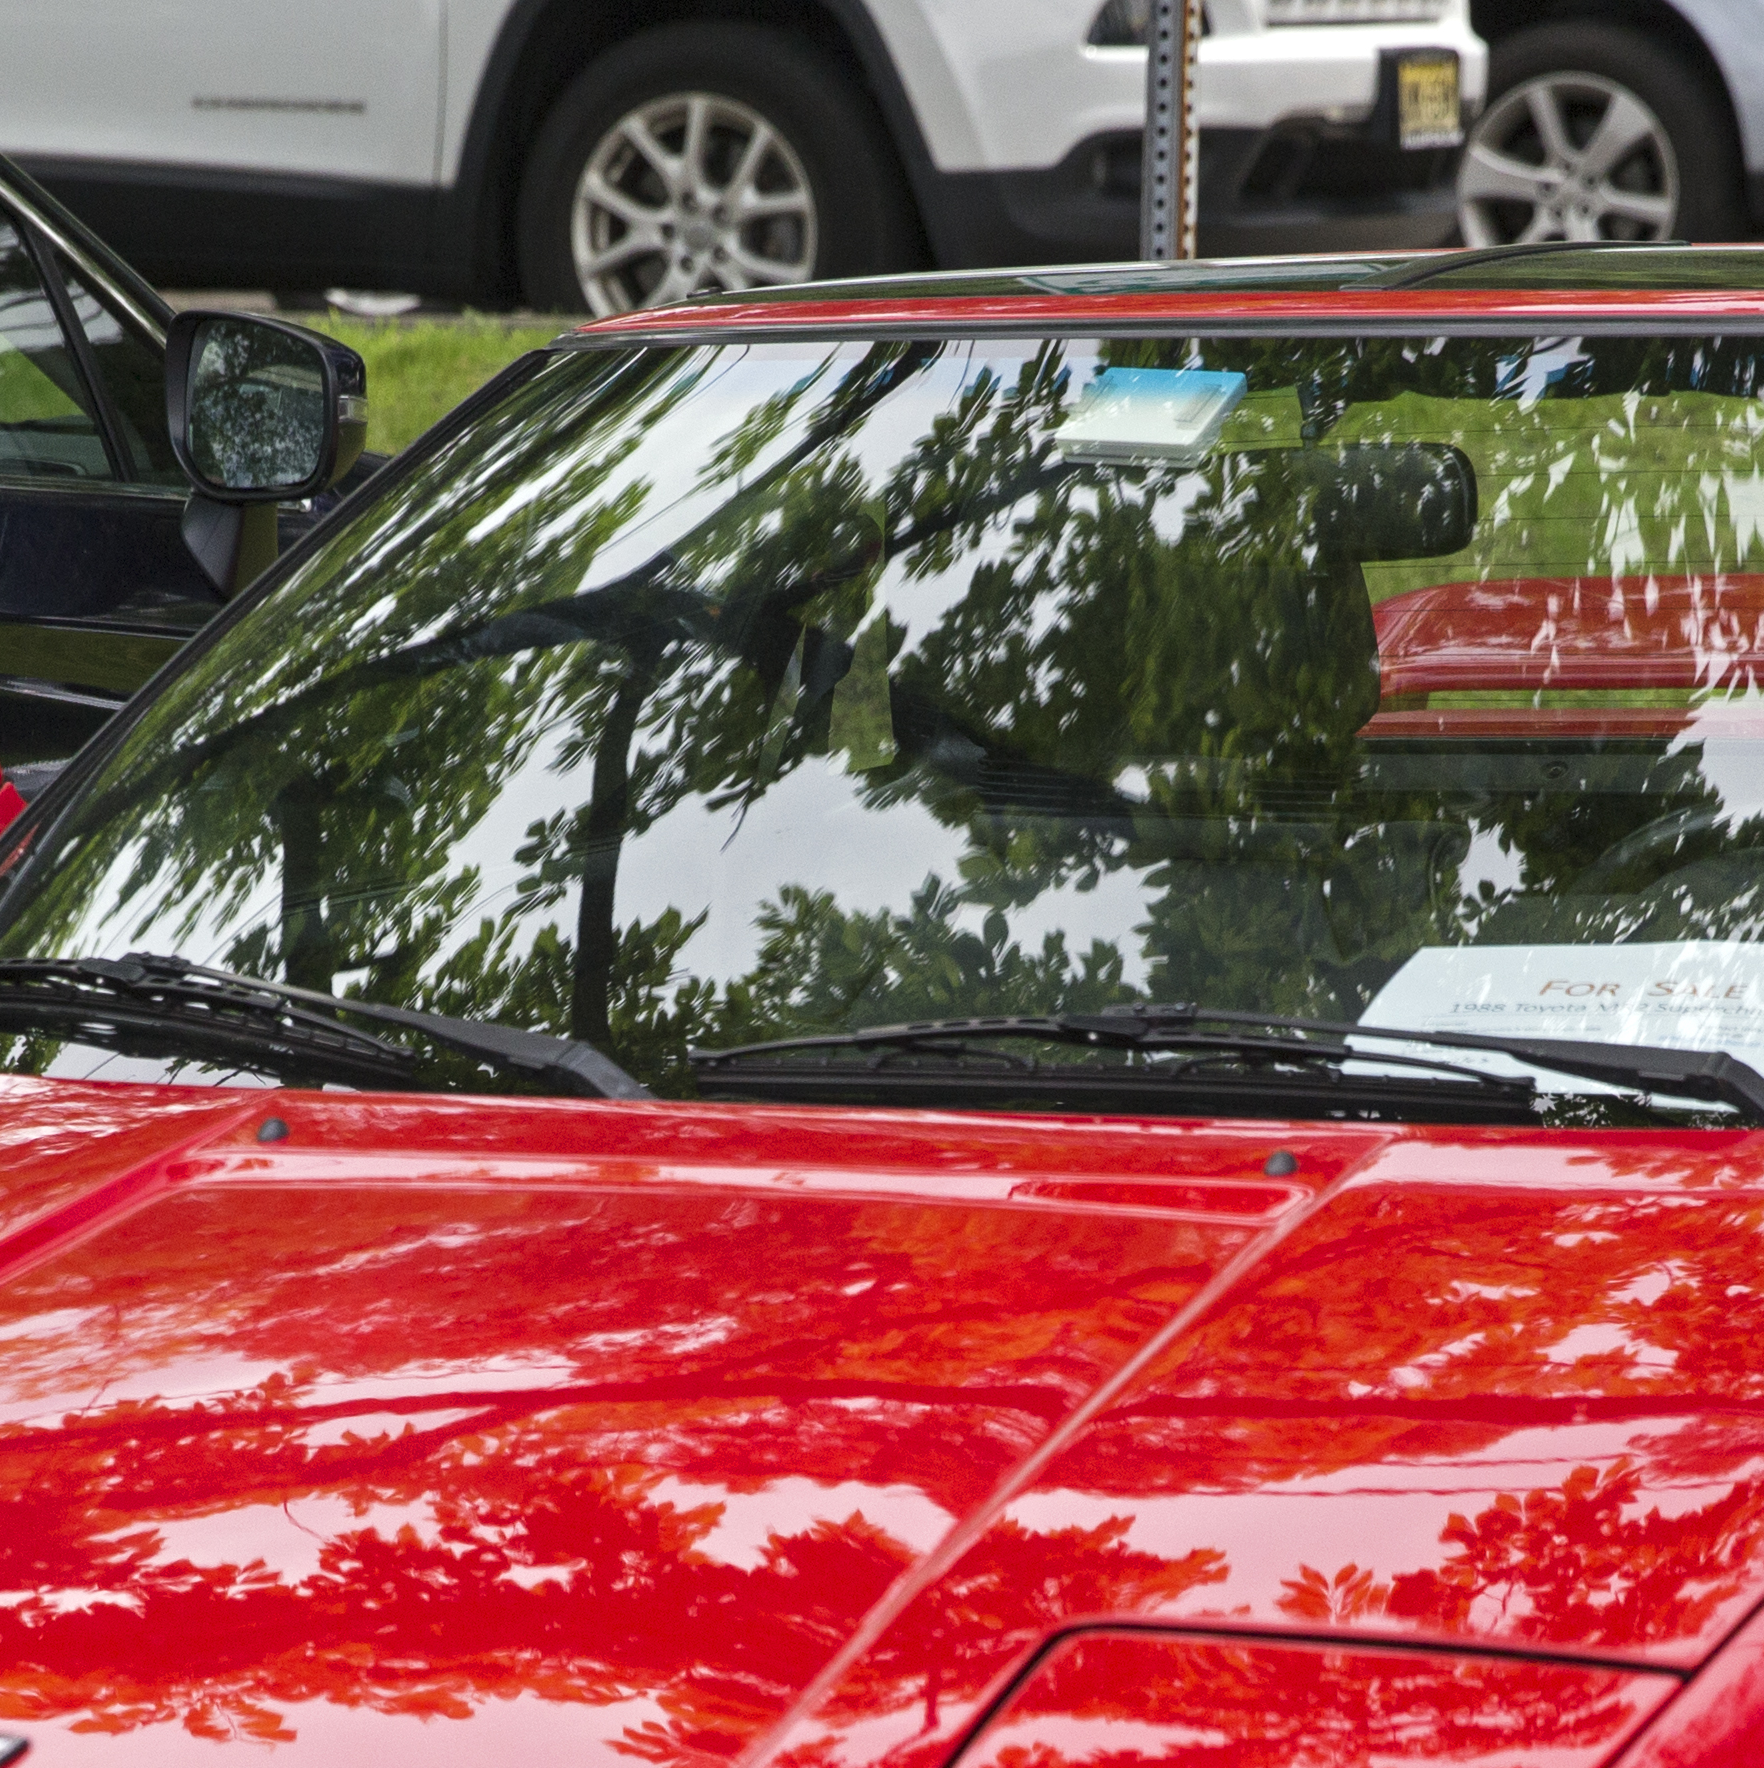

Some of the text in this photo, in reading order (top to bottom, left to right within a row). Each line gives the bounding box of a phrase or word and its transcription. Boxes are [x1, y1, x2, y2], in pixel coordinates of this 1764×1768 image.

[1539, 980, 1748, 999] FOR SALE
[1450, 1003, 1507, 1014] 1988
[1515, 1003, 1587, 1014] Toyota
[1596, 1003, 1648, 1013] M2
